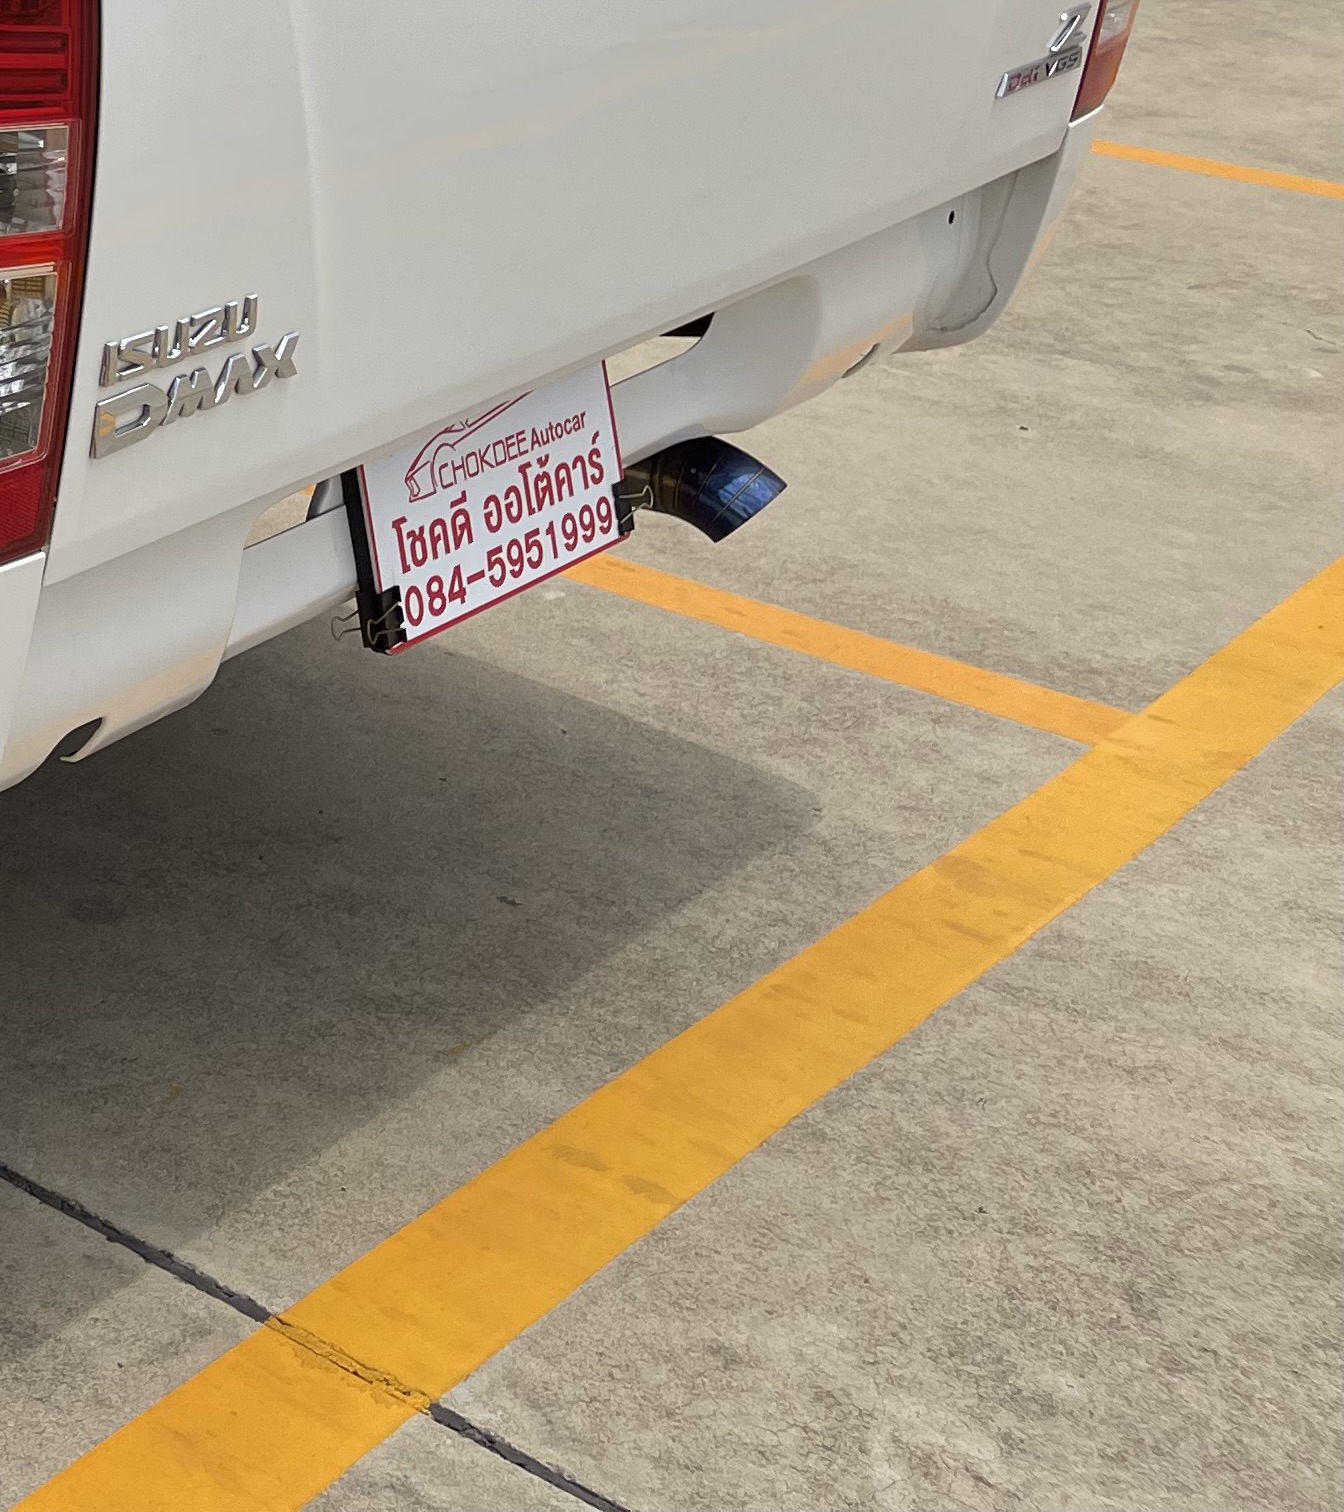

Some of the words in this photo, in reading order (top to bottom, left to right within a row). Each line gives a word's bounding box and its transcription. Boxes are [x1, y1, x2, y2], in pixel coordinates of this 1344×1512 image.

[1045, 51, 1079, 77] VGS
[98, 292, 259, 387] ISUZU
[437, 429, 529, 490] CHOKDEE
[530, 411, 587, 452] Autocar
[391, 491, 474, 575] โชคดี
[483, 430, 605, 533] ออโต้คาร์
[404, 494, 614, 627] 084-5951999
